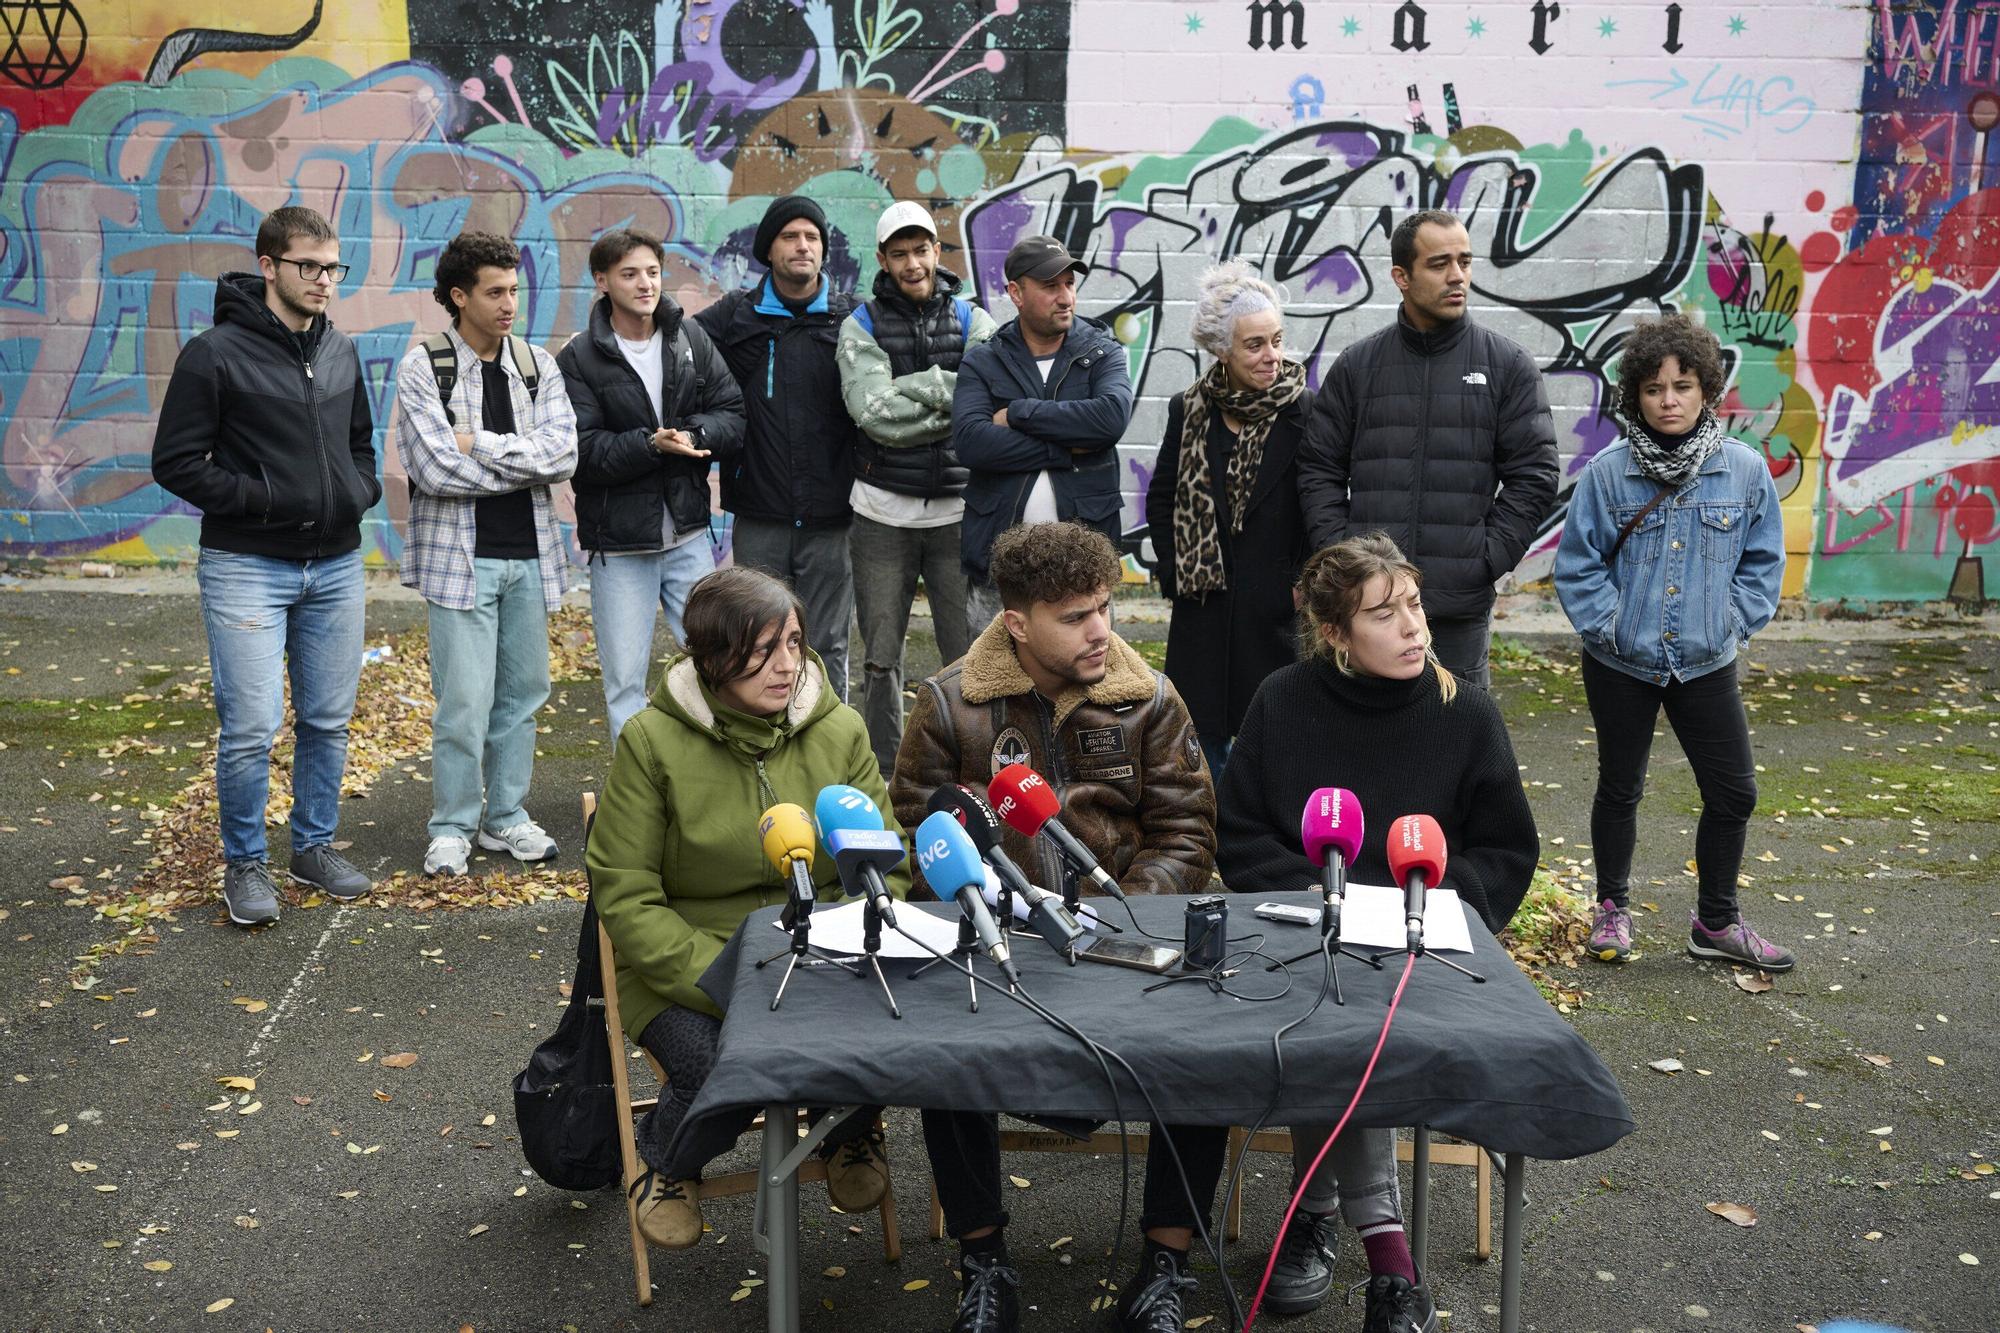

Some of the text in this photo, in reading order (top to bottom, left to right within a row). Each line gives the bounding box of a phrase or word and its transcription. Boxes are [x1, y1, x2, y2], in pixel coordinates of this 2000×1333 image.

[996, 730, 1016, 750] AVIATOR
[1085, 736, 1117, 748] HERITAGE
[1093, 767, 1131, 778] AIRBORNE
[919, 838, 951, 870] tve
